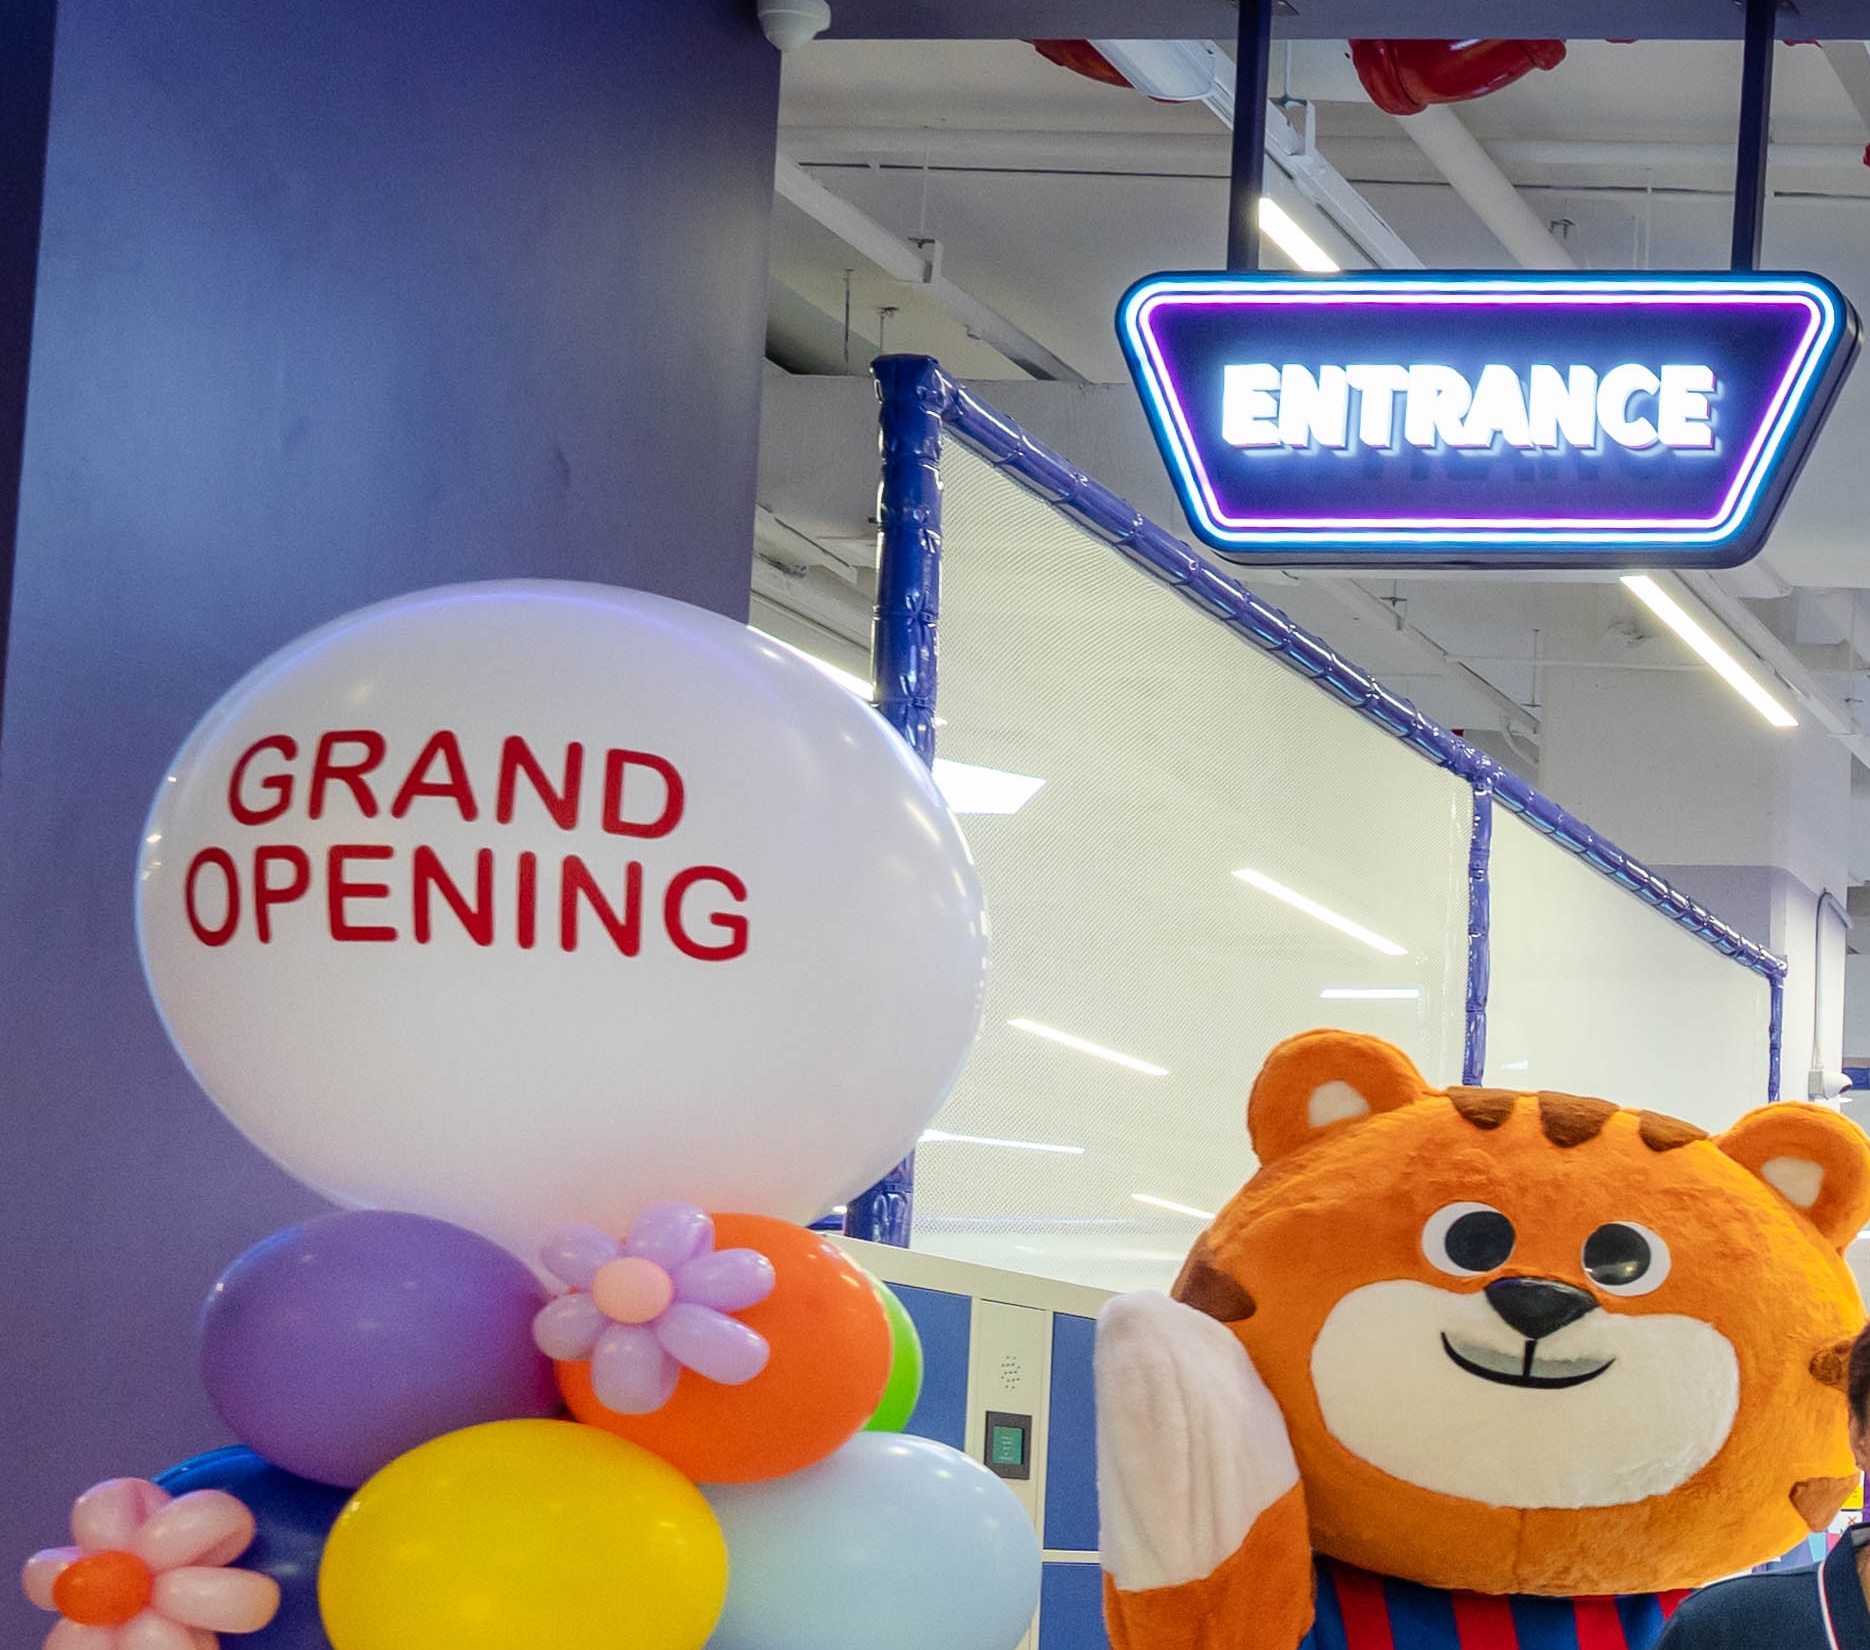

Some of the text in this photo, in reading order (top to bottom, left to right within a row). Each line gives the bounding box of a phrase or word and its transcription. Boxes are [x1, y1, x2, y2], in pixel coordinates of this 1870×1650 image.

[1222, 362, 1716, 449] ENTRANCE
[228, 729, 686, 840] GRAND
[185, 844, 749, 962] OPENING
